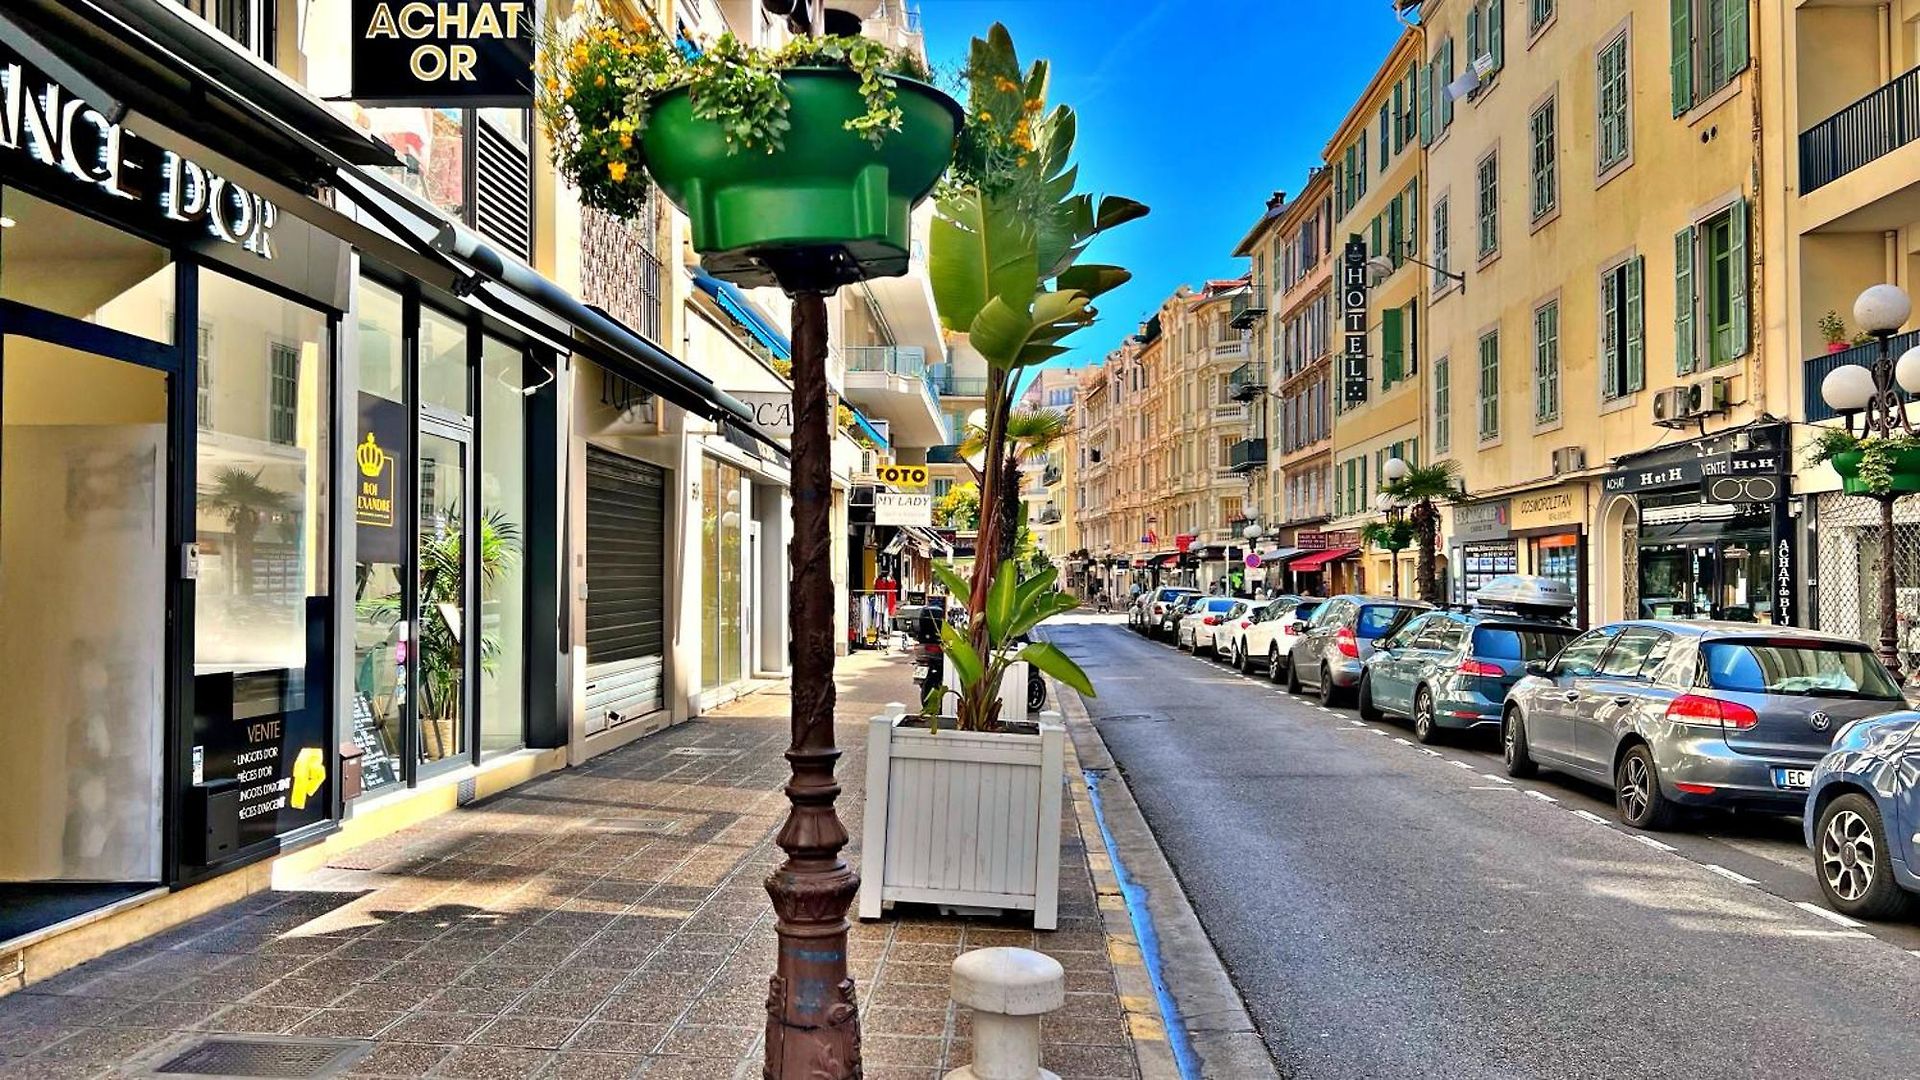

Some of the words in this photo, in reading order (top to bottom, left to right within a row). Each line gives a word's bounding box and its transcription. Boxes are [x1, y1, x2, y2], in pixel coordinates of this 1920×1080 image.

[365, 2, 524, 39] ACHAT
[409, 44, 477, 82] OR
[1347, 268, 1364, 376] HOTEL
[1606, 476, 1626, 490] ACHAT
[1640, 474, 1653, 486] H
[1669, 468, 1683, 481] H
[1701, 461, 1726, 476] VENTE
[363, 482, 378, 496] ROI
[898, 496, 930, 507] LADY
[1521, 493, 1572, 514] COSMOPOLITAN
[1778, 539, 1790, 587] ACHAT
[247, 721, 281, 743] VENTE
[237, 751, 263, 766] LINGOTS
[1788, 771, 1806, 785] EC
